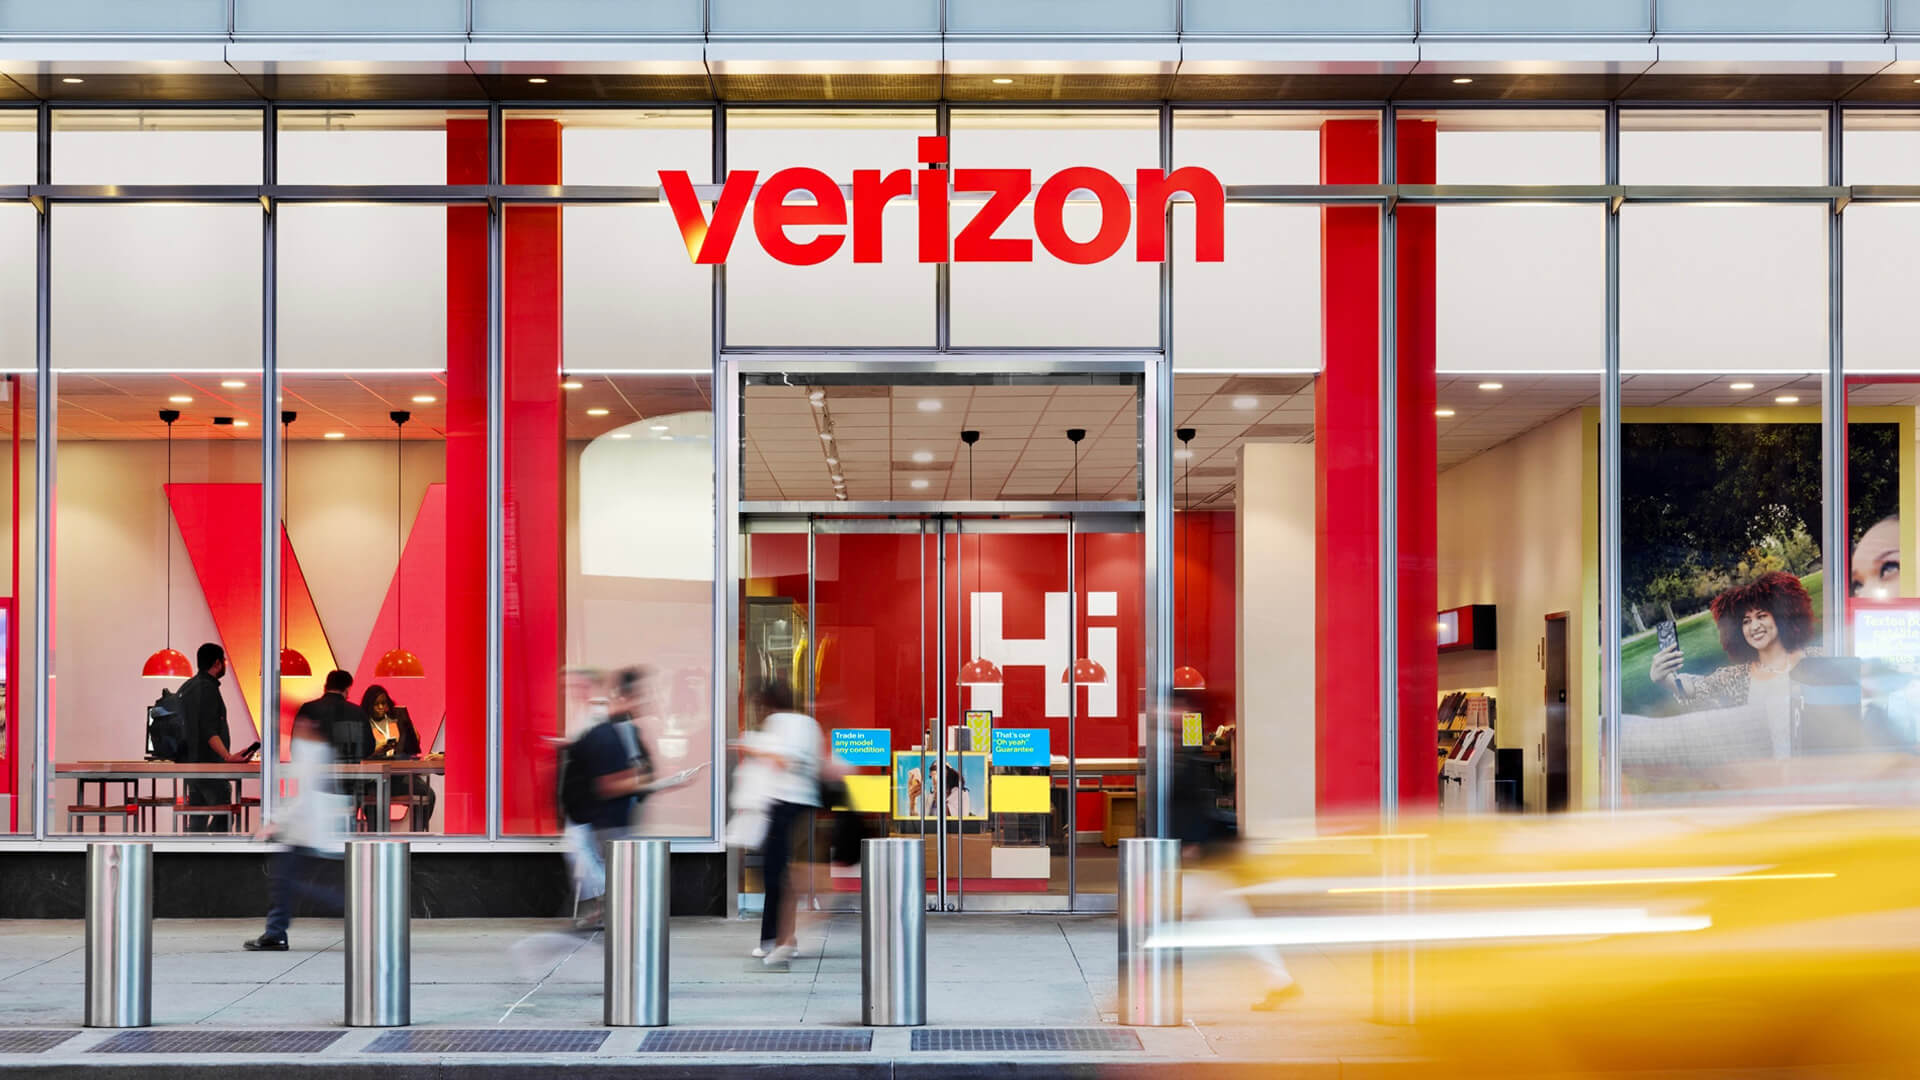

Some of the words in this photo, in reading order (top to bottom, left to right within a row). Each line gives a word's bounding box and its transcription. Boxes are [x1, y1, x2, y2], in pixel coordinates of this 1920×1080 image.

[657, 136, 1225, 265] verizon
[970, 592, 1117, 697] Hi
[835, 731, 857, 739] Trade
[858, 731, 865, 739] in
[835, 740, 849, 748] any
